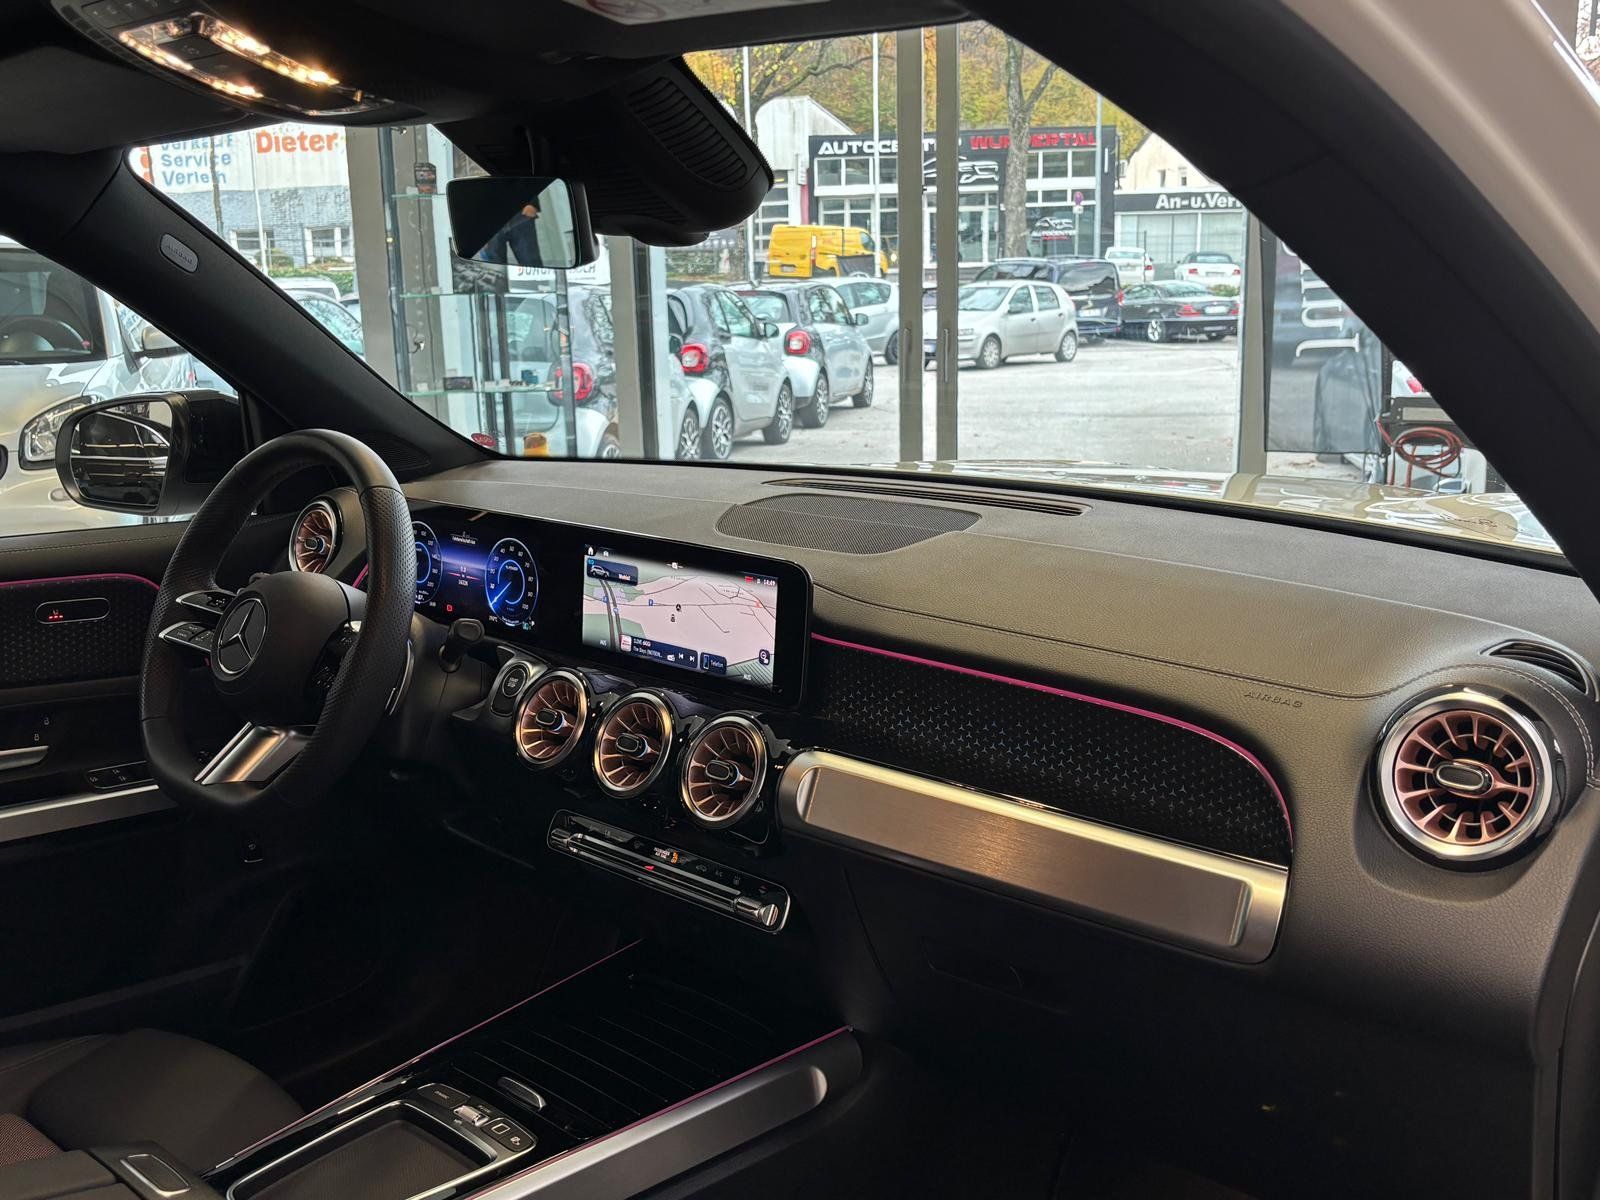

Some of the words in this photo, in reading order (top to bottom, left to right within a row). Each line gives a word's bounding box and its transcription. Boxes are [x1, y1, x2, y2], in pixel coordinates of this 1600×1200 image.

[256, 130, 339, 153] Dieter
[162, 170, 227, 187] Verleh
[1244, 691, 1302, 708] AIRBAG
